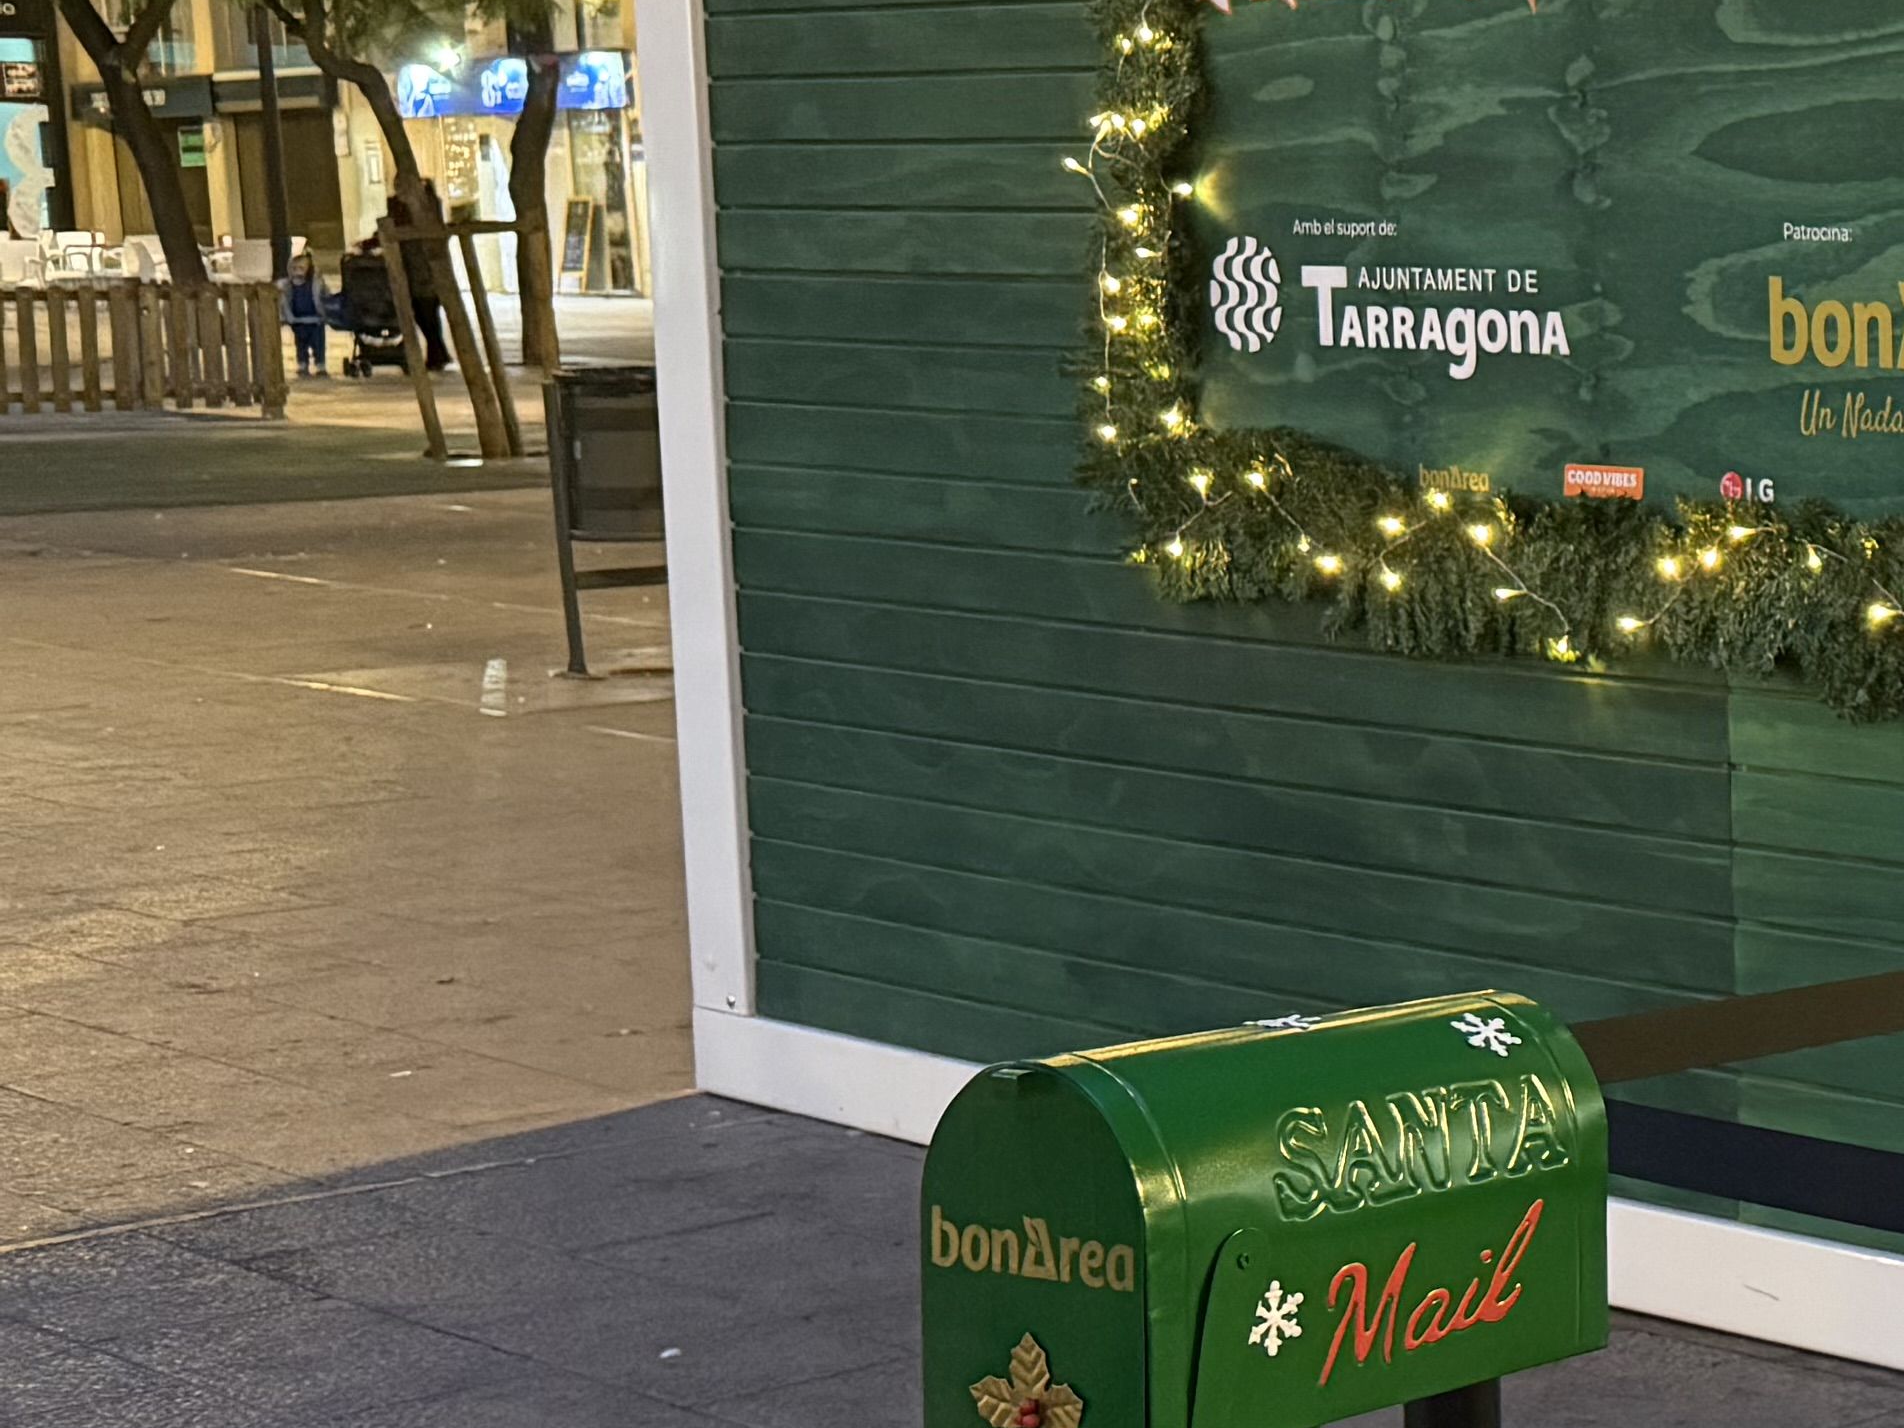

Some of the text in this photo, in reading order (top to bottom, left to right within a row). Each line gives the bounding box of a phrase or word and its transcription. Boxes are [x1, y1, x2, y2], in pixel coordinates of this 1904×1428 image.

[1293, 218, 1397, 239] Amb el suport de:
[1783, 222, 1853, 242] Patrocina:
[1358, 266, 1539, 294] AJUNTAMENT DE
[1800, 389, 1836, 437] Un
[1272, 1072, 1570, 1223] SANTA
[930, 1204, 1136, 1293] bonArea
[1318, 1198, 1544, 1387] Mail
